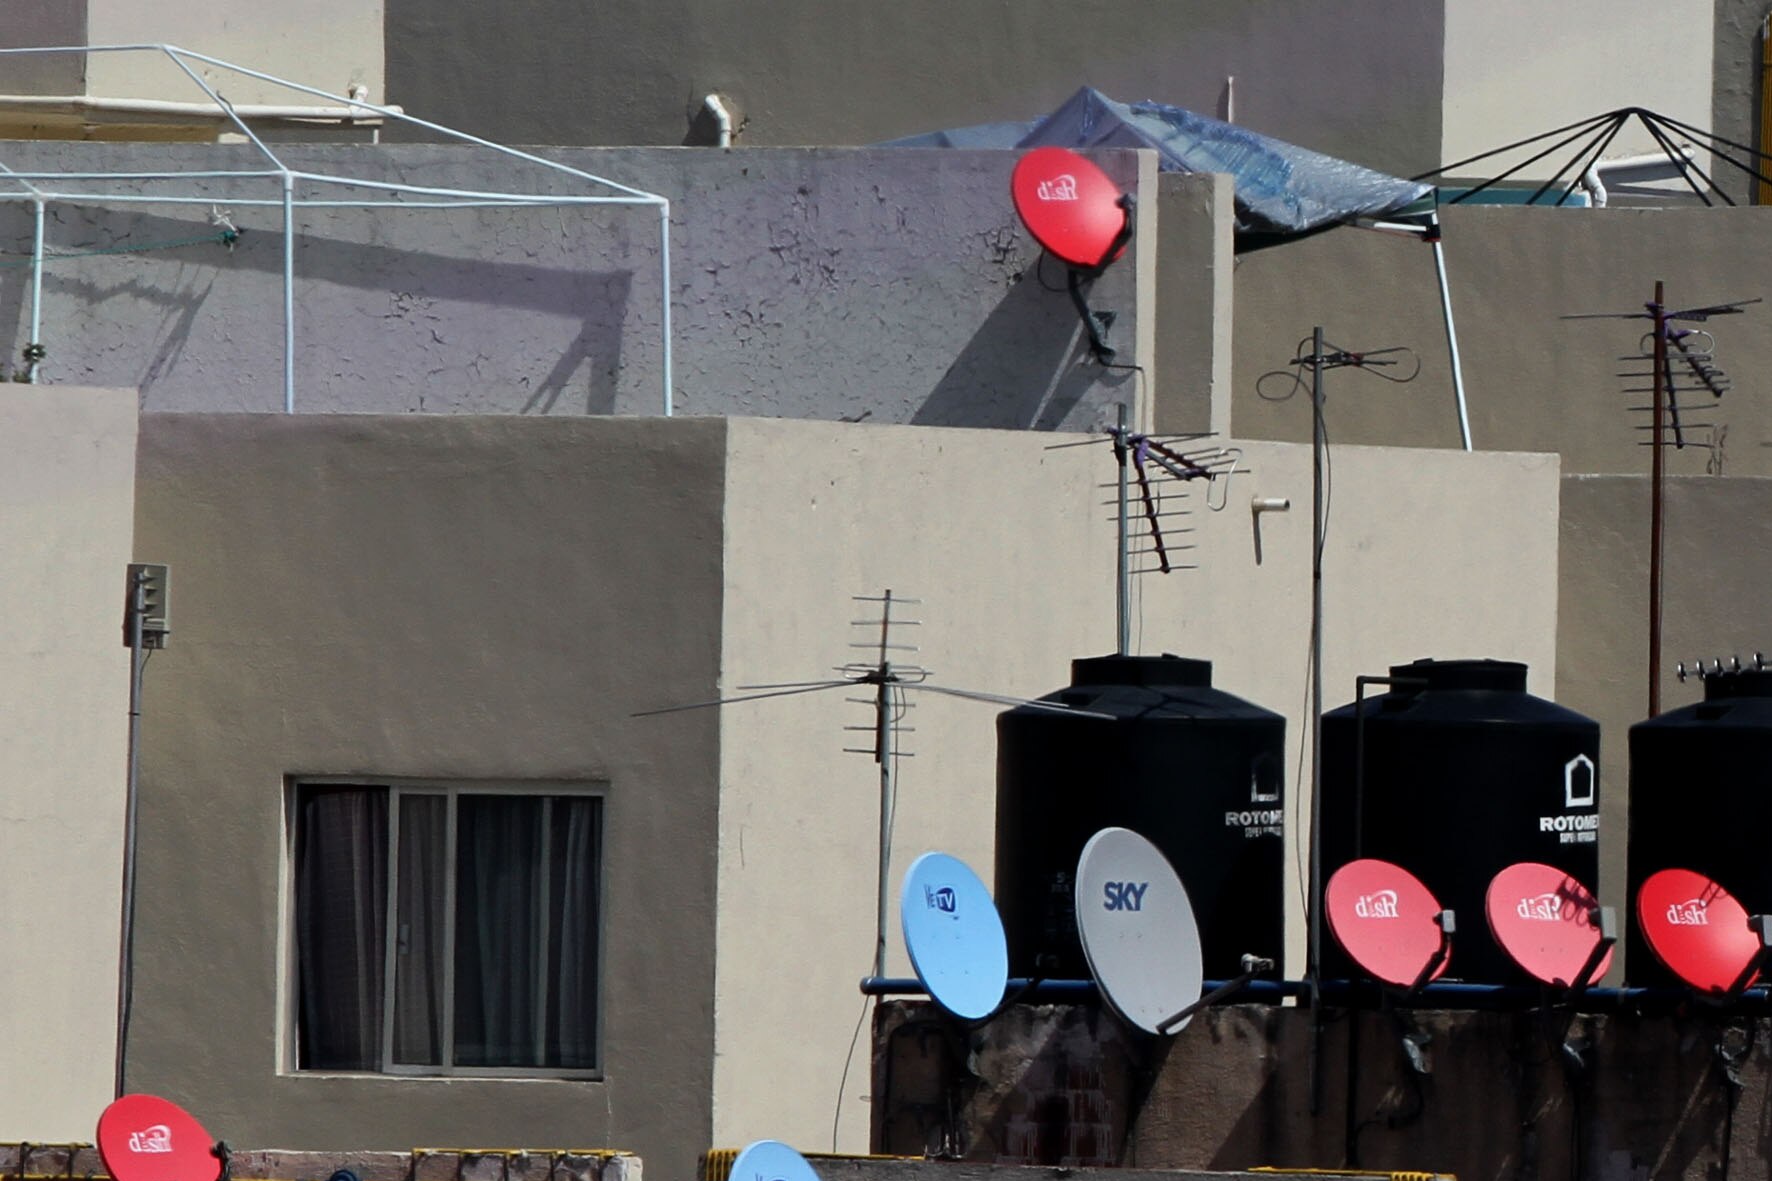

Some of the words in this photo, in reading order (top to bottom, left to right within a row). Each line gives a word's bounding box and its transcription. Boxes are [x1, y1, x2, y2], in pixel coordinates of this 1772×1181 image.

[1037, 174, 1078, 201] dish
[1103, 881, 1149, 911] SKY
[1355, 889, 1399, 918] dish
[1516, 893, 1561, 920] dish
[1666, 898, 1708, 925] dish
[128, 1125, 173, 1153] dish
